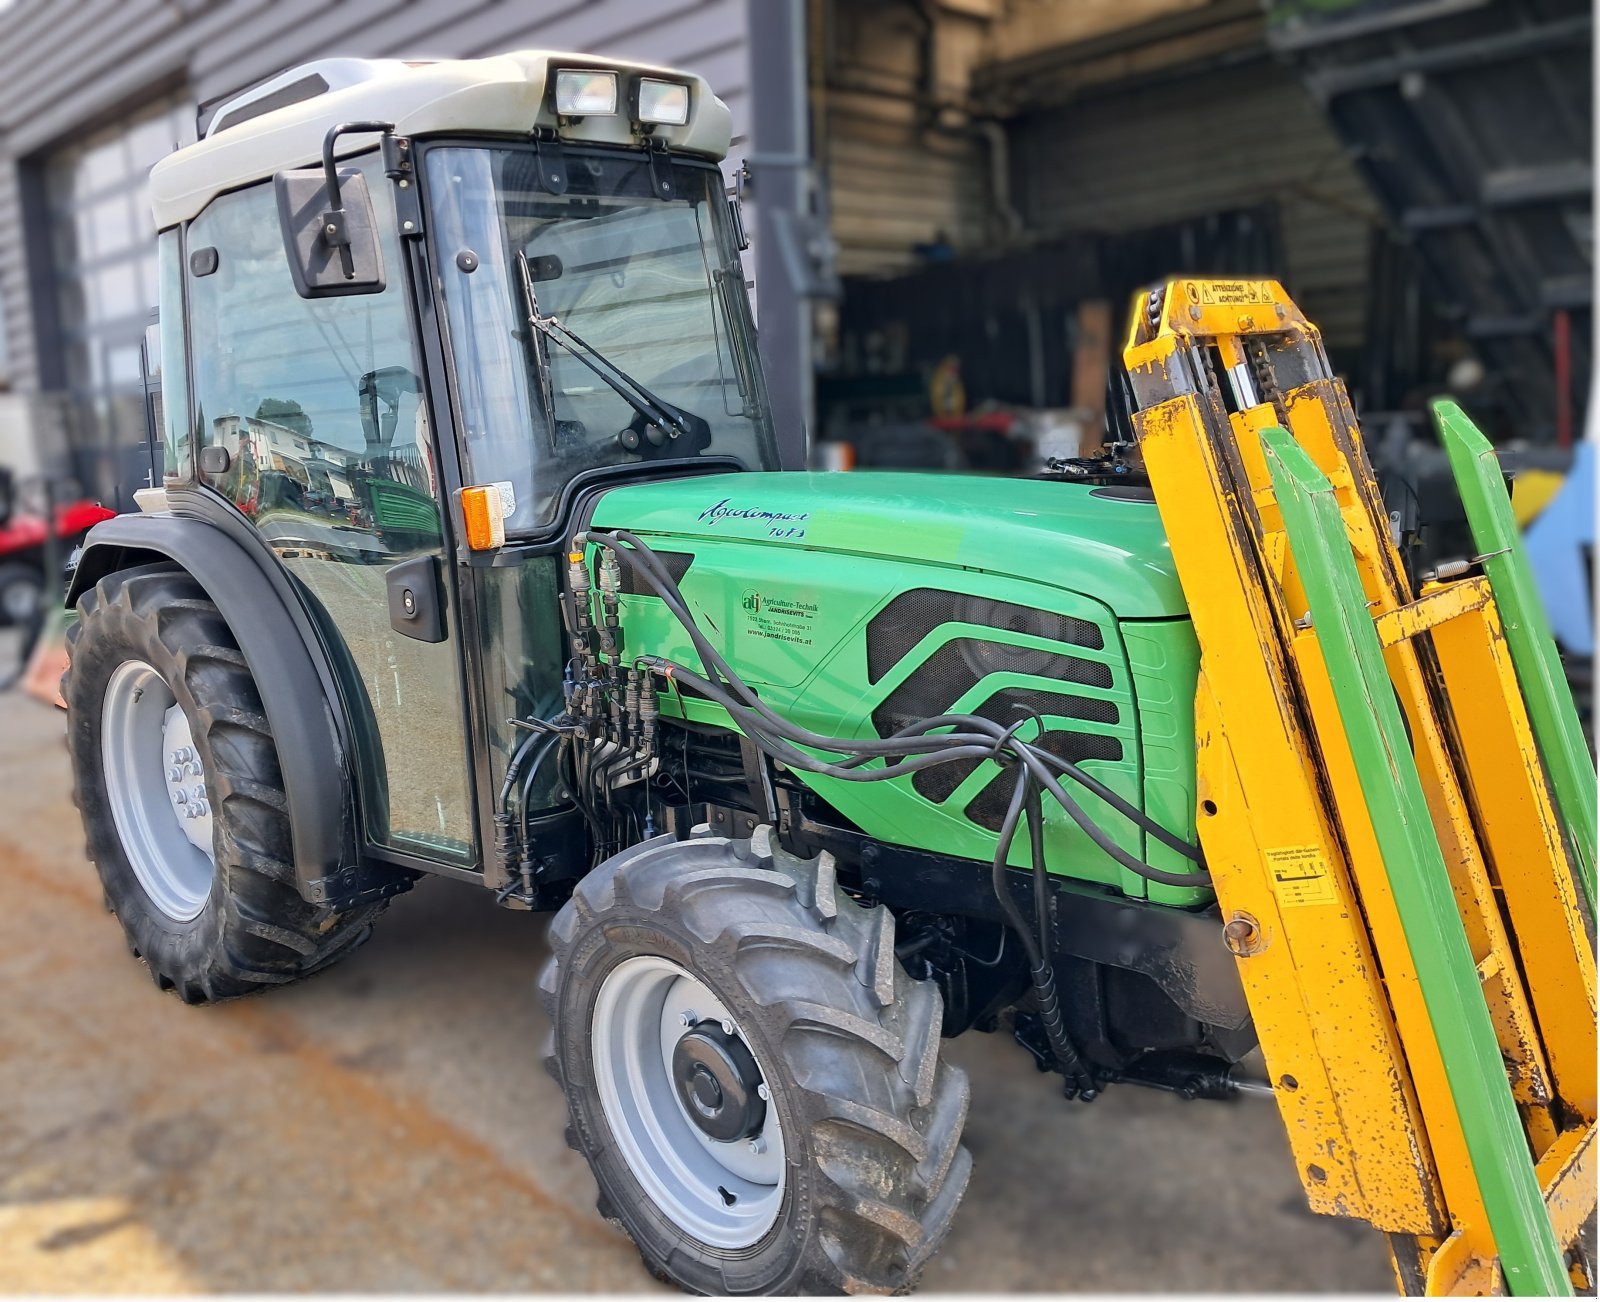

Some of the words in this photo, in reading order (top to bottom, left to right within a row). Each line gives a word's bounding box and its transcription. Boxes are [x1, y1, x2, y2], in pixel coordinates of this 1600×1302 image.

[762, 597, 818, 612] Agriculture-Technik
[768, 607, 804, 618] JANDRISEVITS
[747, 629, 812, 645] www.jandrisevits.at
